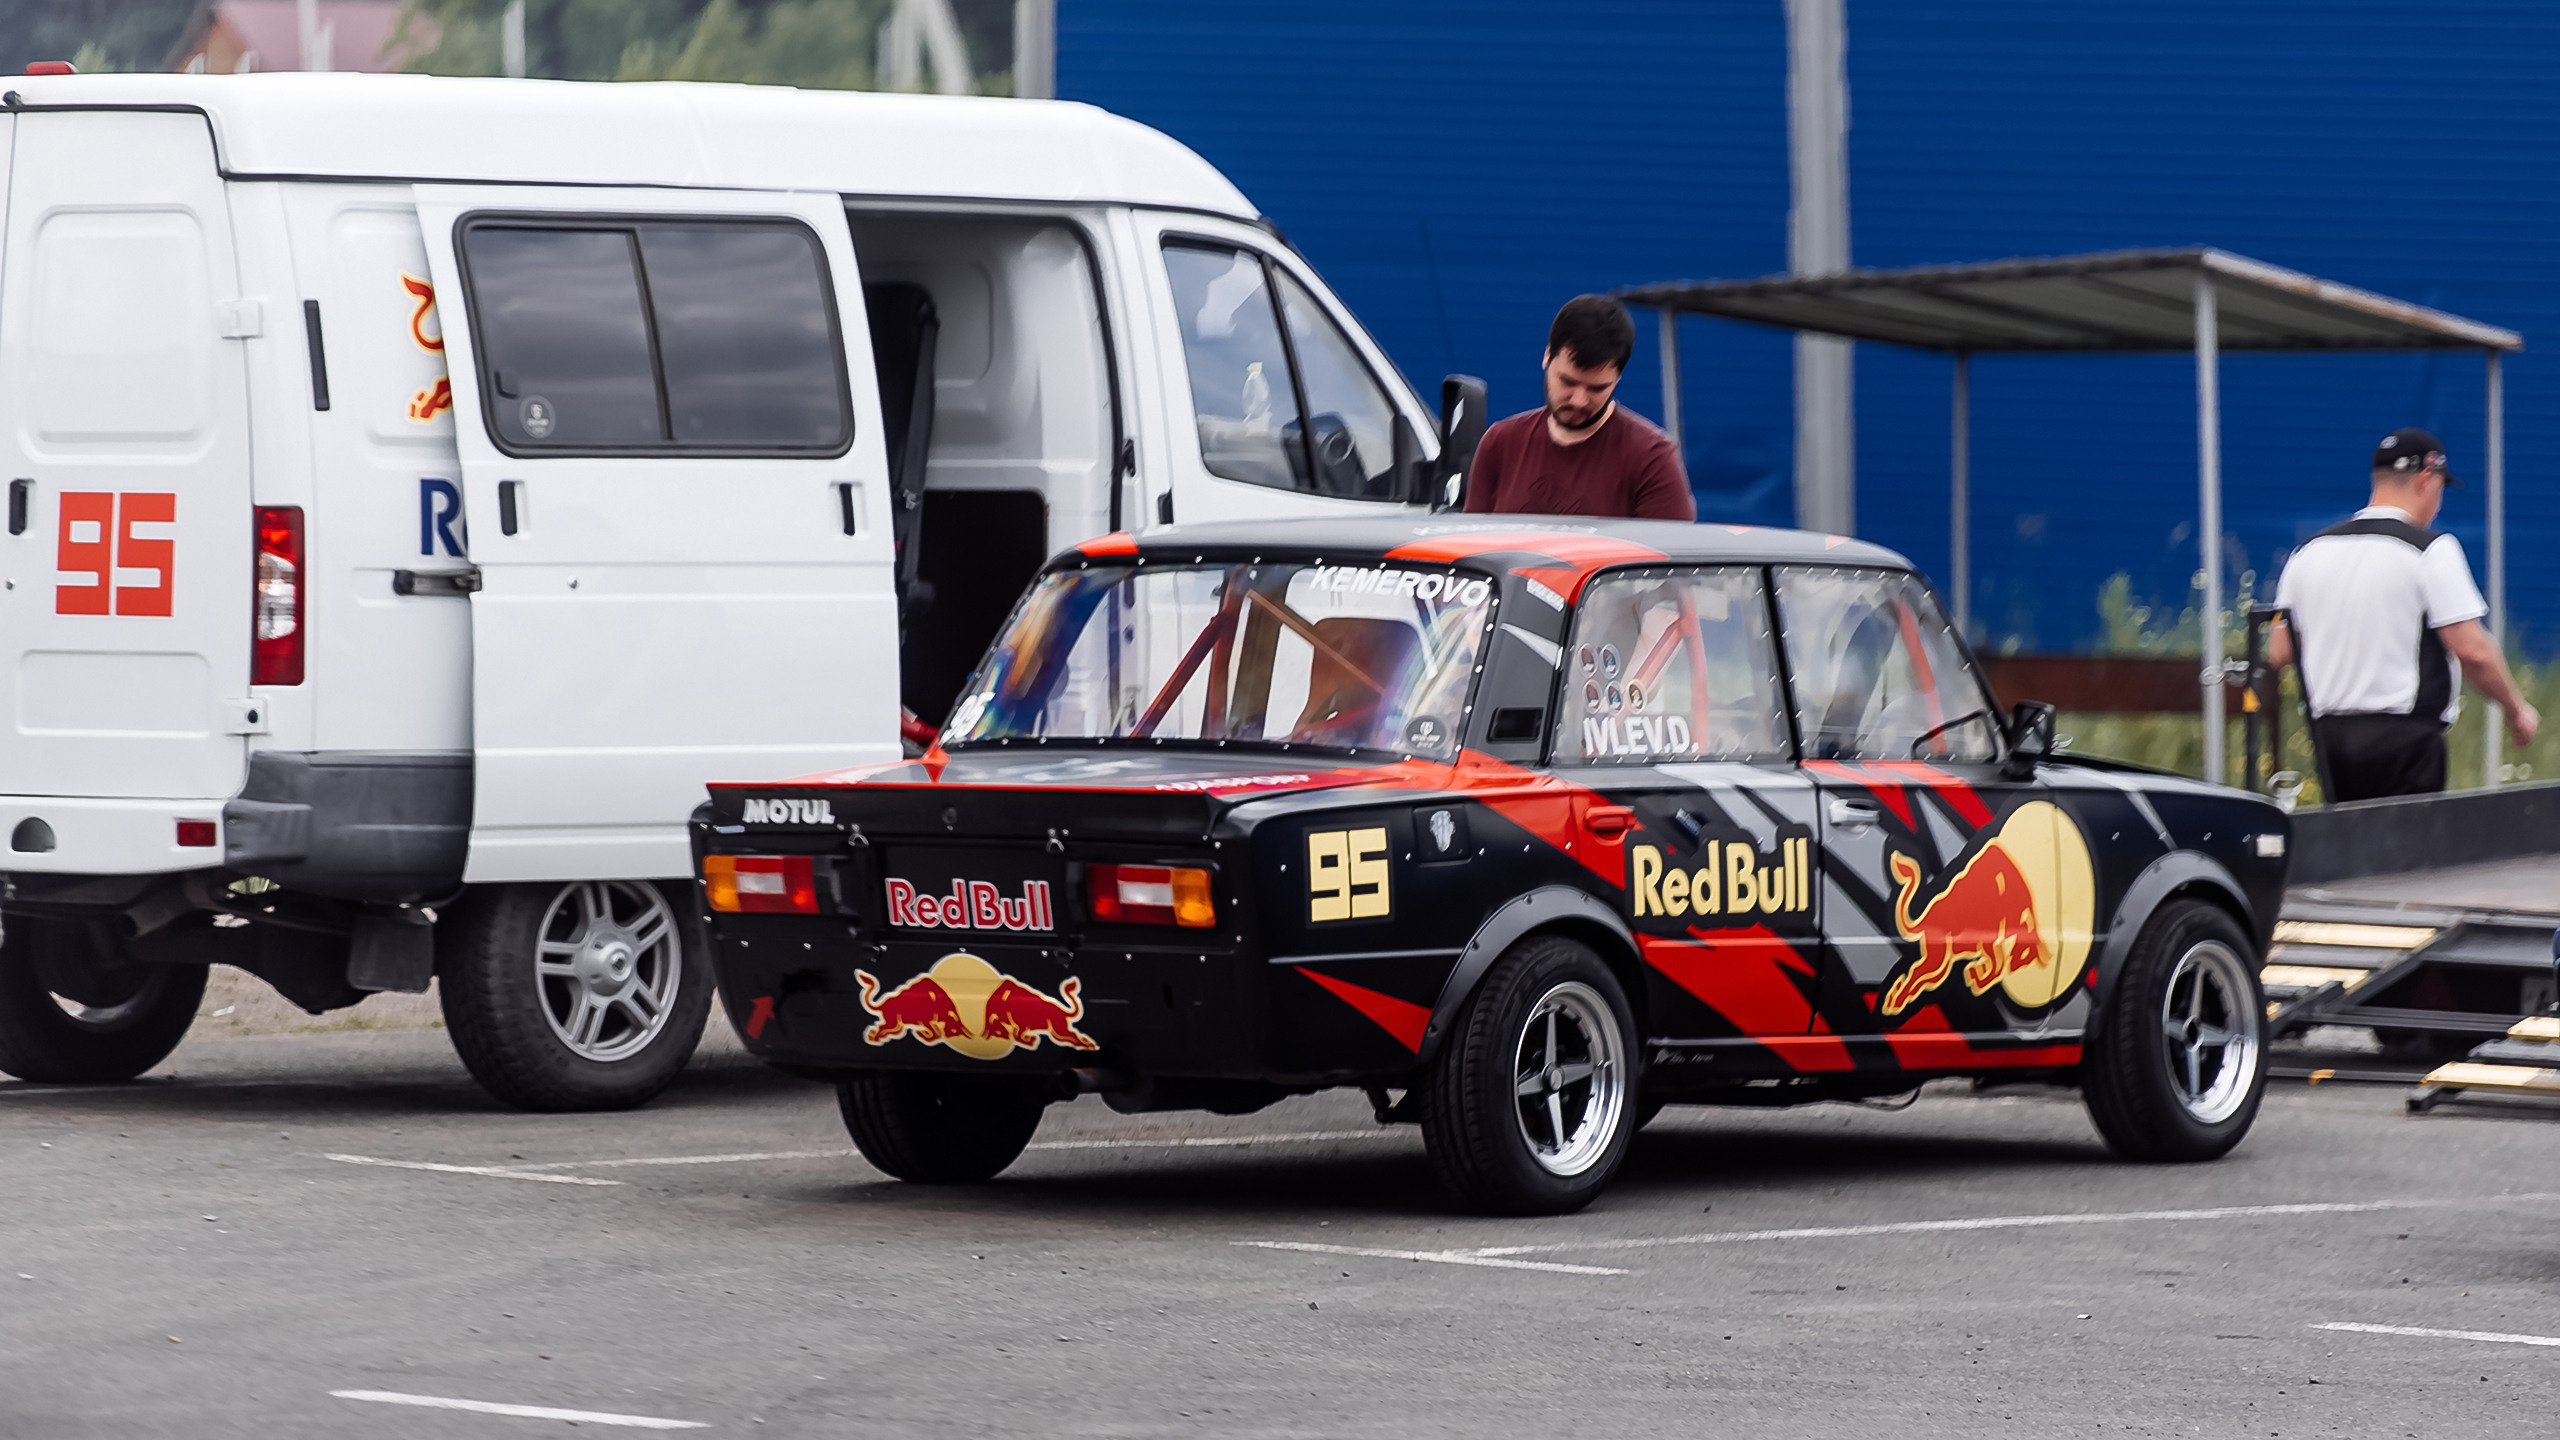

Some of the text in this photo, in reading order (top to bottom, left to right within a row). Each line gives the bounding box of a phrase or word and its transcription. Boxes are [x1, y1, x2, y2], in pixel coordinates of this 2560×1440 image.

[56, 492, 176, 617] 95
[420, 478, 468, 558] R
[1309, 565, 1491, 607] KEMEROVO
[742, 799, 836, 825] MOTUL
[885, 877, 1054, 931] Red Bull
[1309, 827, 1390, 922] 95
[1632, 837, 1808, 917] Red Bull
